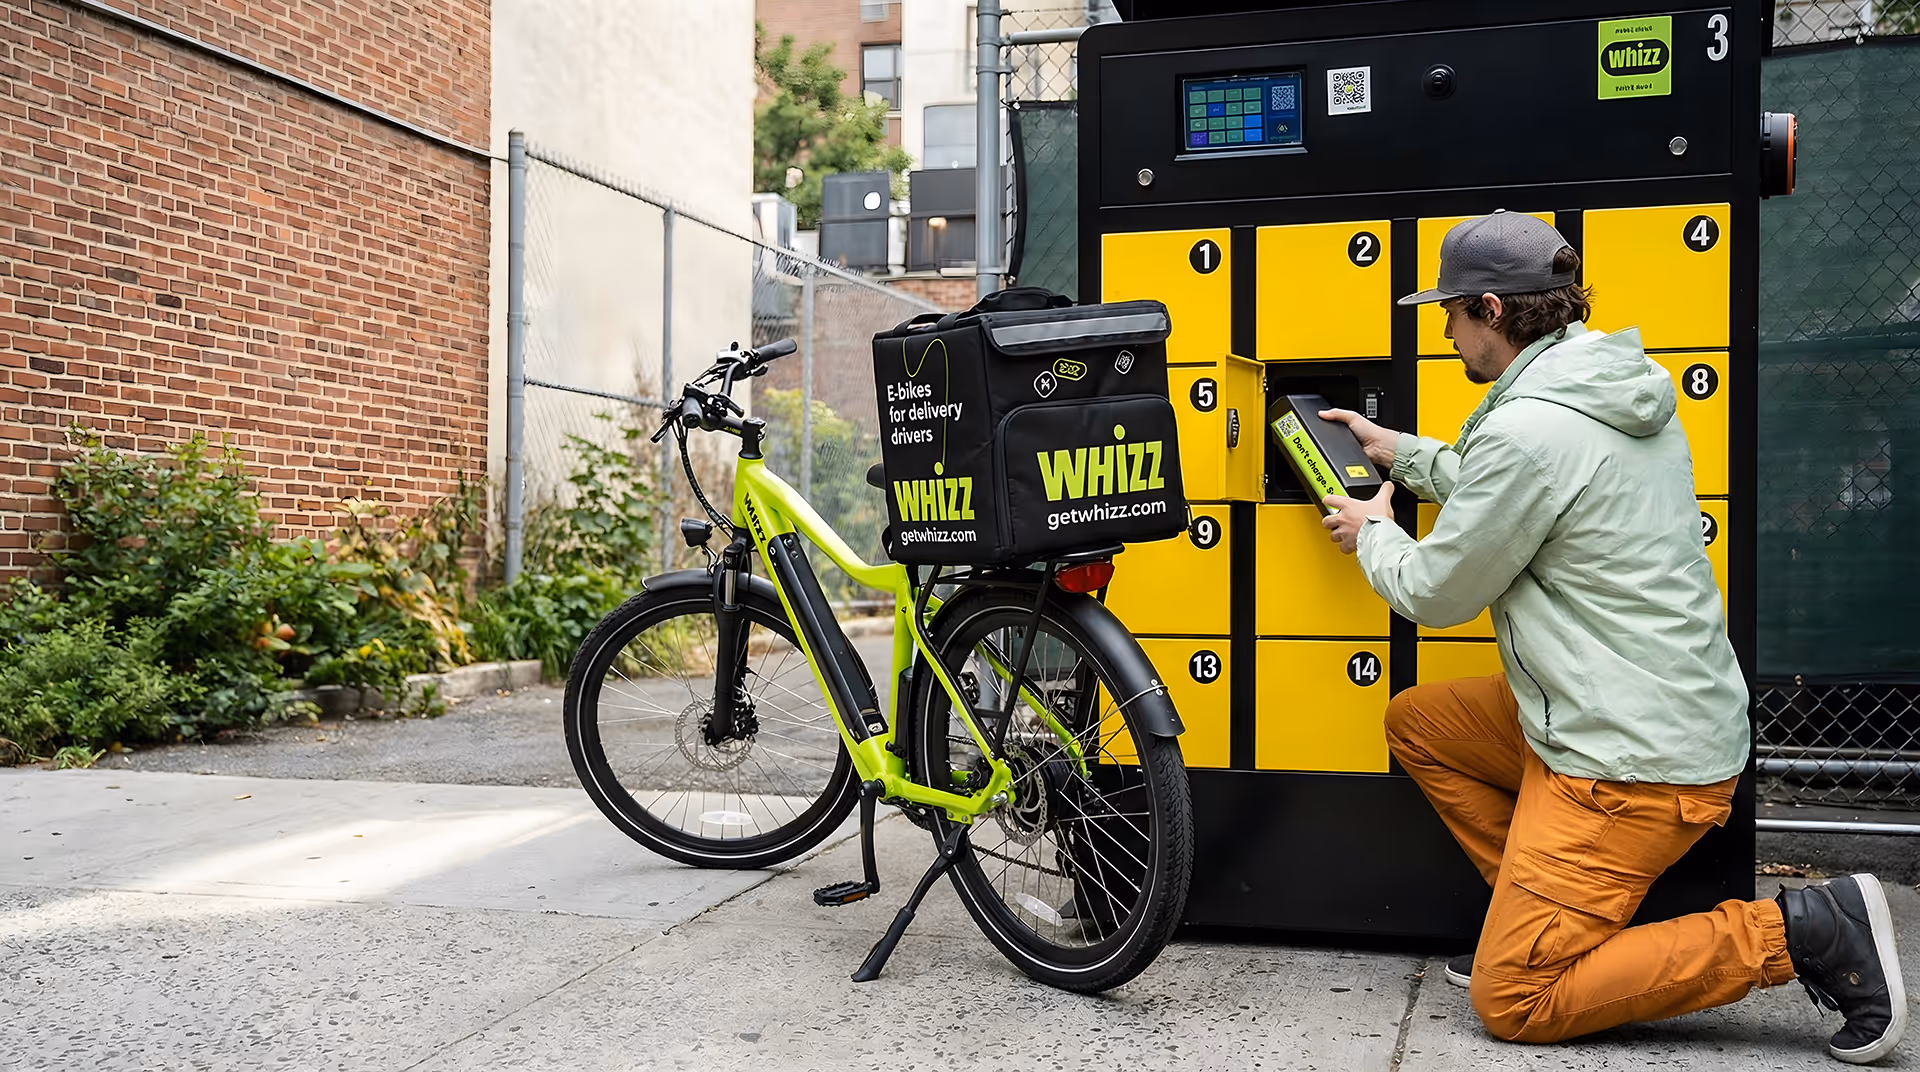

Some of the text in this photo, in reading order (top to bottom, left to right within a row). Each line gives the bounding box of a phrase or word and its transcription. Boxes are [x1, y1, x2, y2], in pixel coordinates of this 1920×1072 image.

[1706, 13, 1729, 62] 3
[1691, 219, 1709, 246] 4
[1199, 243, 1210, 269] 1
[1356, 235, 1373, 262] 2
[886, 380, 932, 402] E-bikes
[1198, 382, 1214, 407] 5
[1691, 368, 1709, 395] 8
[889, 400, 963, 424] for delivery
[891, 426, 934, 445] drivers
[1292, 436, 1310, 460] Don't
[1307, 458, 1327, 488] charge.
[1047, 499, 1167, 531] getwhizz.com
[900, 526, 977, 546] getwhizz.com
[1197, 519, 1213, 545] 9
[1194, 654, 1217, 678] 13
[1352, 657, 1378, 681] 14
